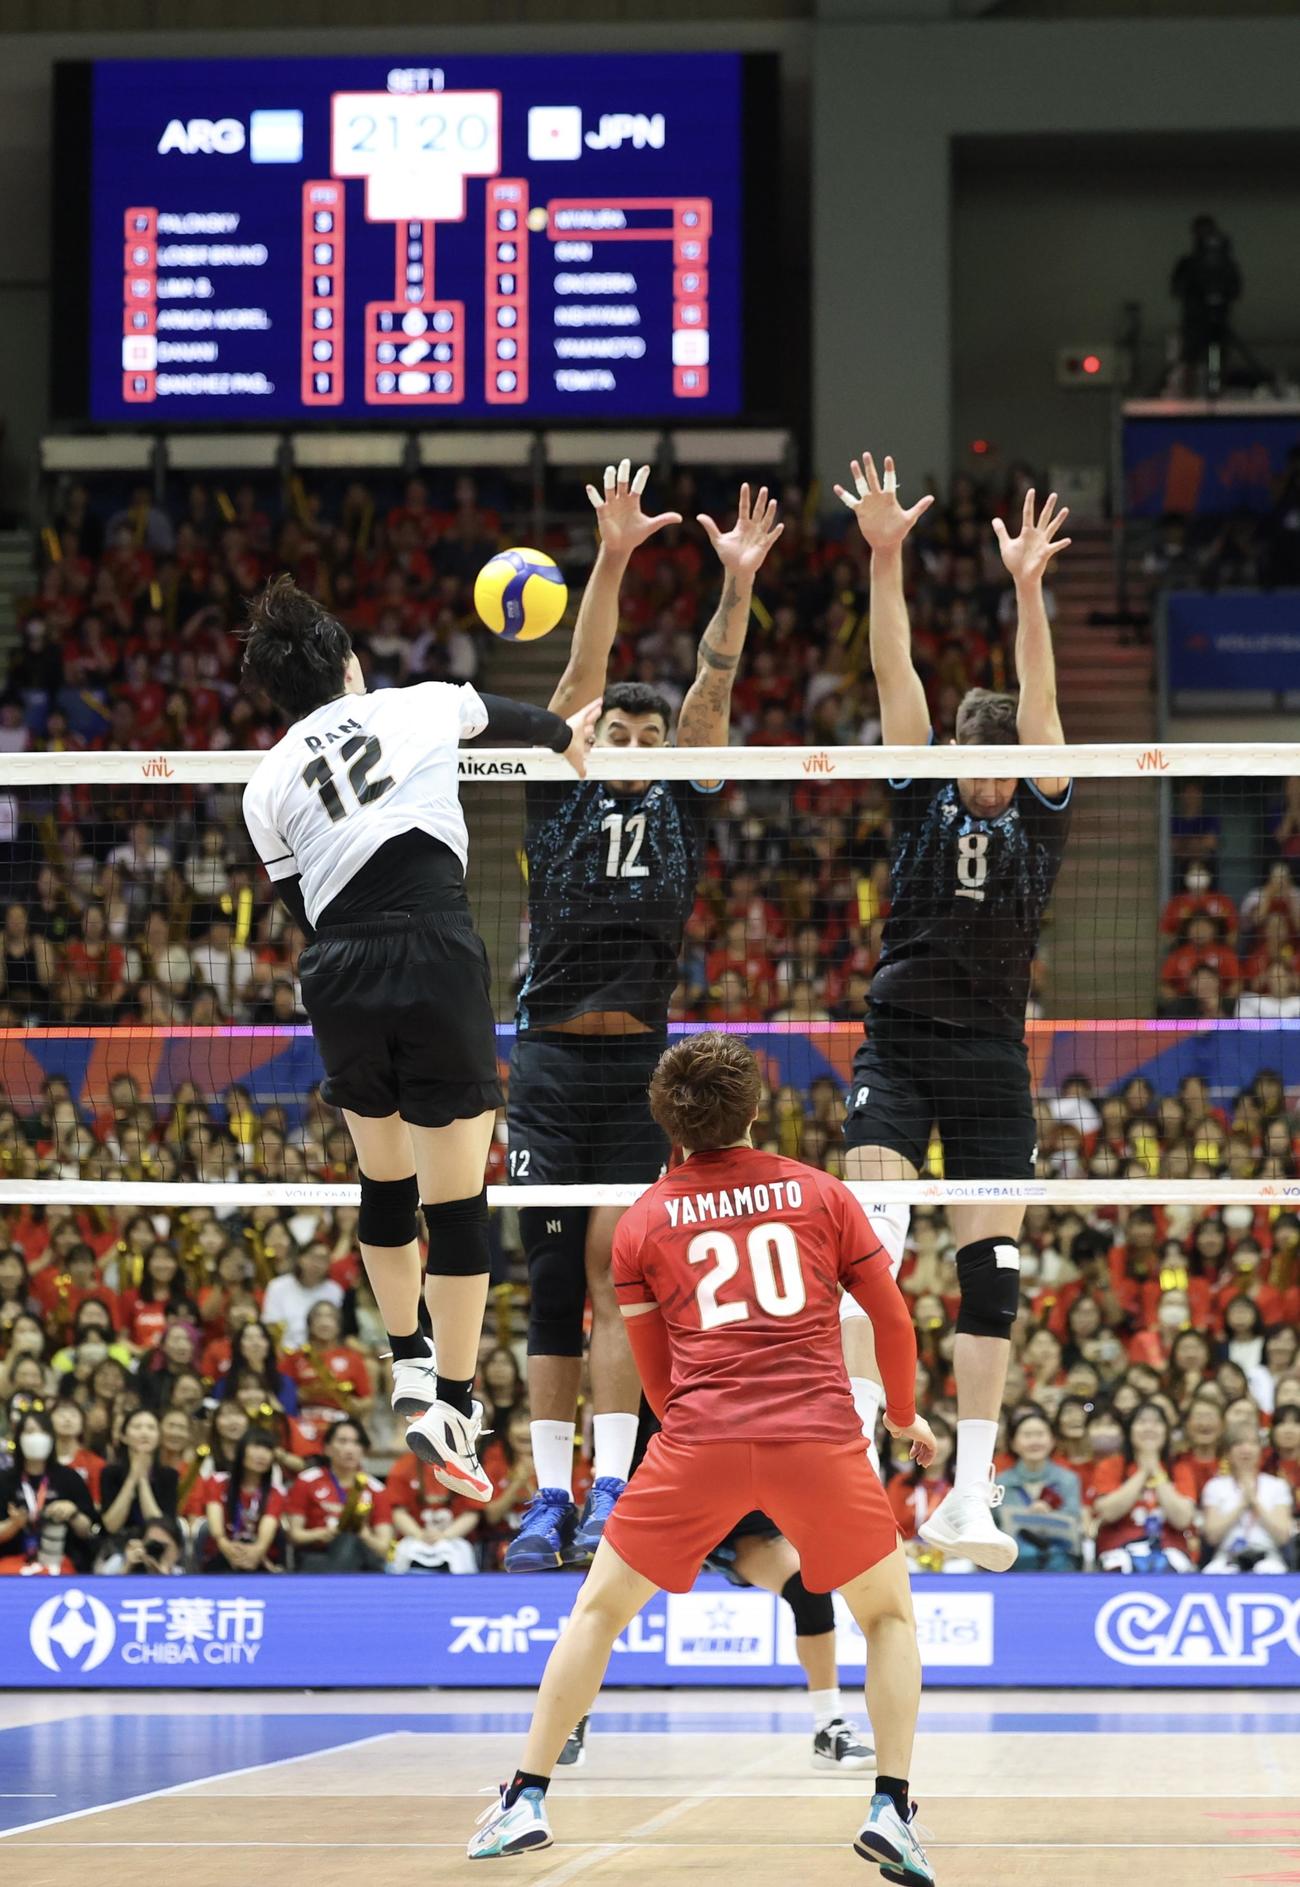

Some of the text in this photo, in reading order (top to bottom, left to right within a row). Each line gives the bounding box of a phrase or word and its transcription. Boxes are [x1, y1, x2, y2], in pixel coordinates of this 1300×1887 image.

[157, 118, 246, 154] ARG
[584, 113, 666, 150] JPN
[302, 734, 397, 823] 12
[601, 813, 650, 877] 12
[957, 833, 989, 888] 8
[509, 1150, 531, 1178] 12
[664, 1180, 802, 1228] YAMAMOTO
[946, 1187, 1022, 1197] VOLLEYBALL
[686, 1221, 807, 1331] 20
[118, 1597, 266, 1643] 千葉市
[120, 1642, 261, 1664] CHIBA CITY
